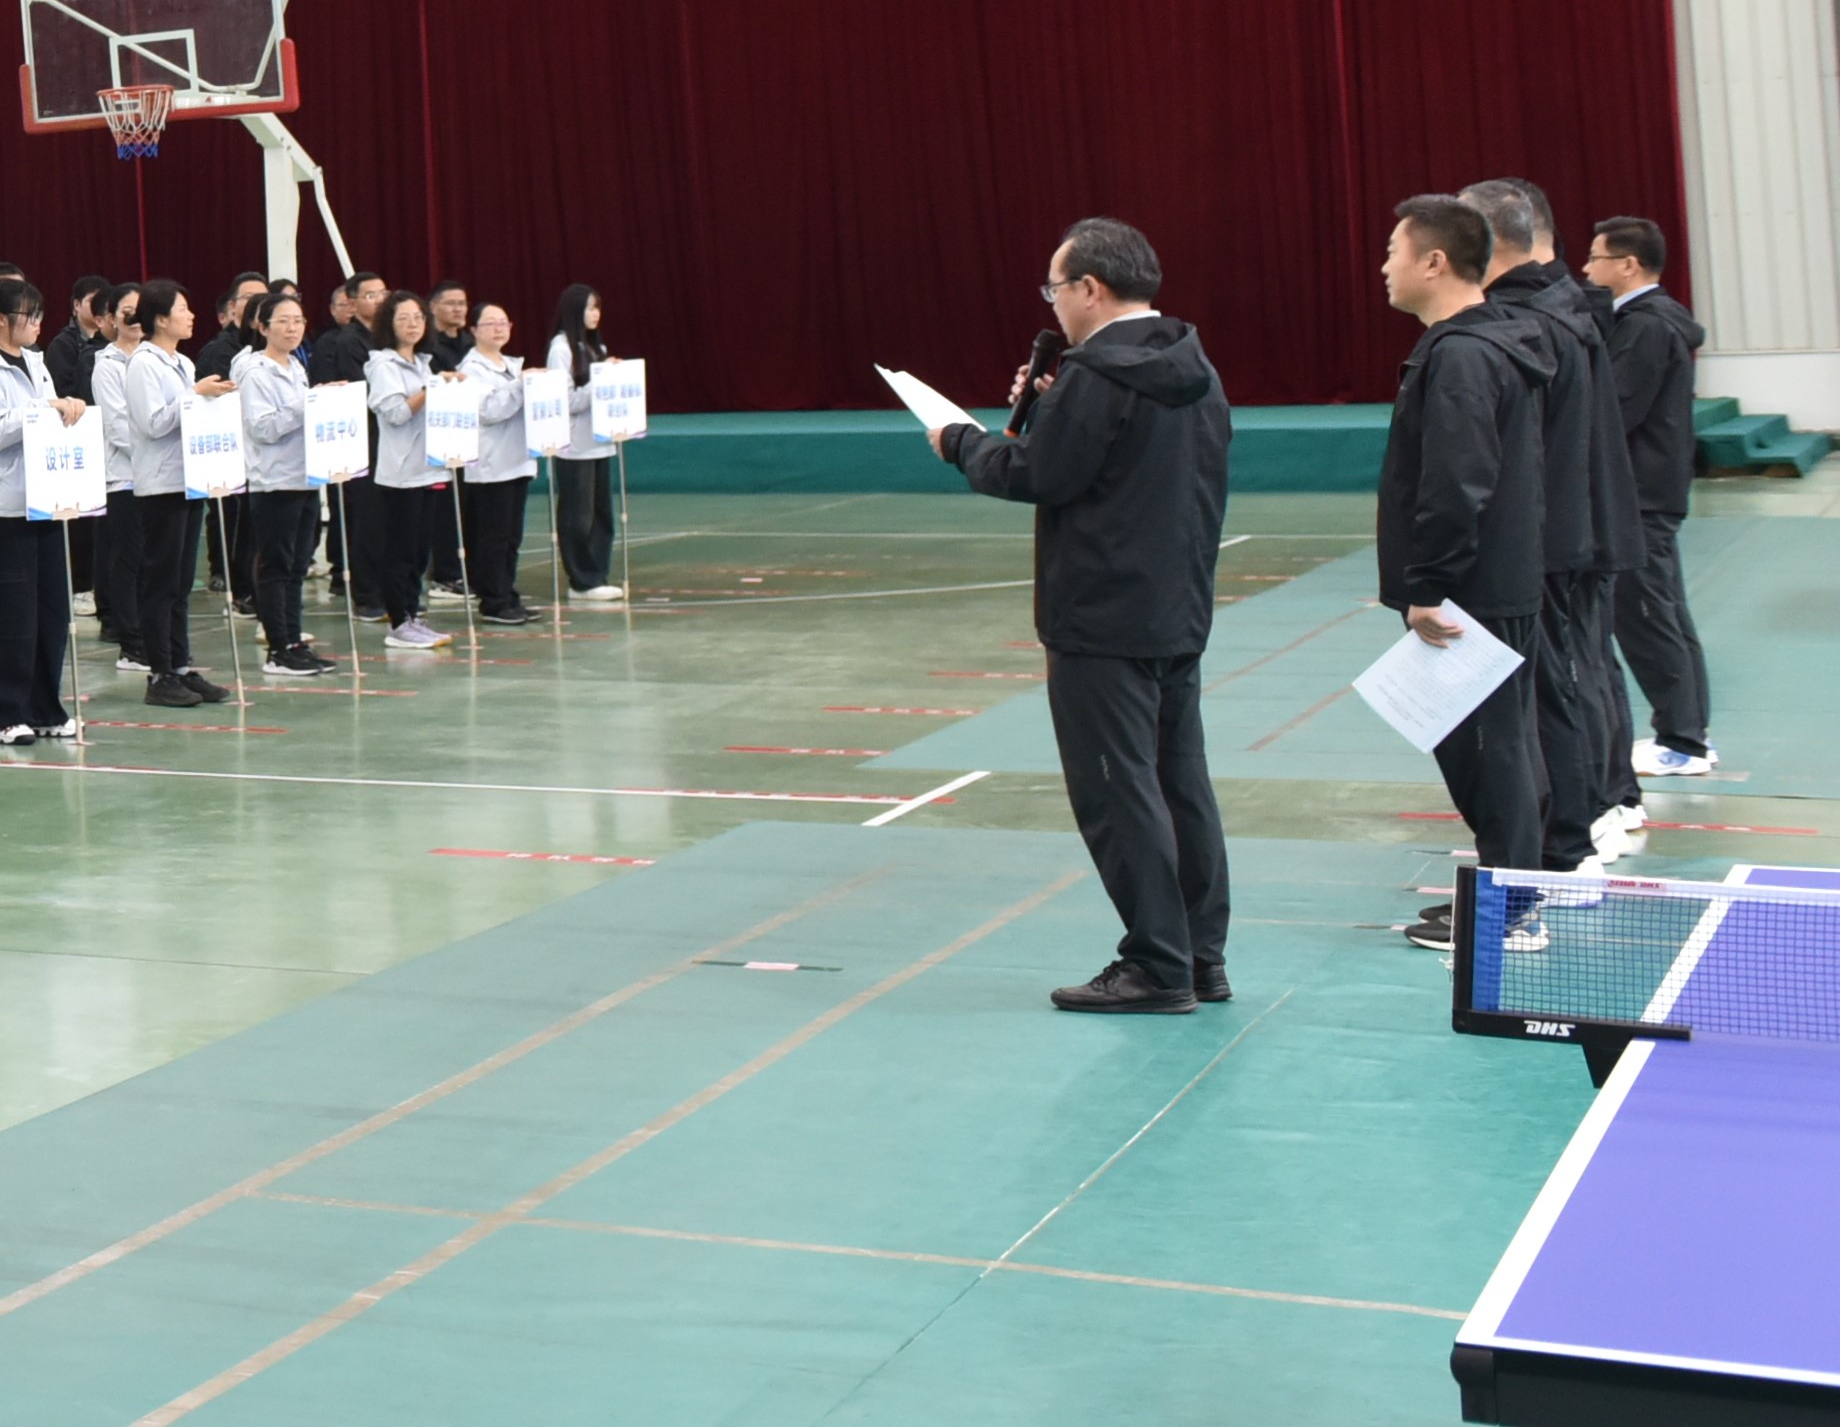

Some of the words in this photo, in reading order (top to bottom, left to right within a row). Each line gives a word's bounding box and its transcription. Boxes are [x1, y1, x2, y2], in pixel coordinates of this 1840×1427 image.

[46, 446, 84, 471] 设计室
[1523, 1020, 1576, 1037] DHS
